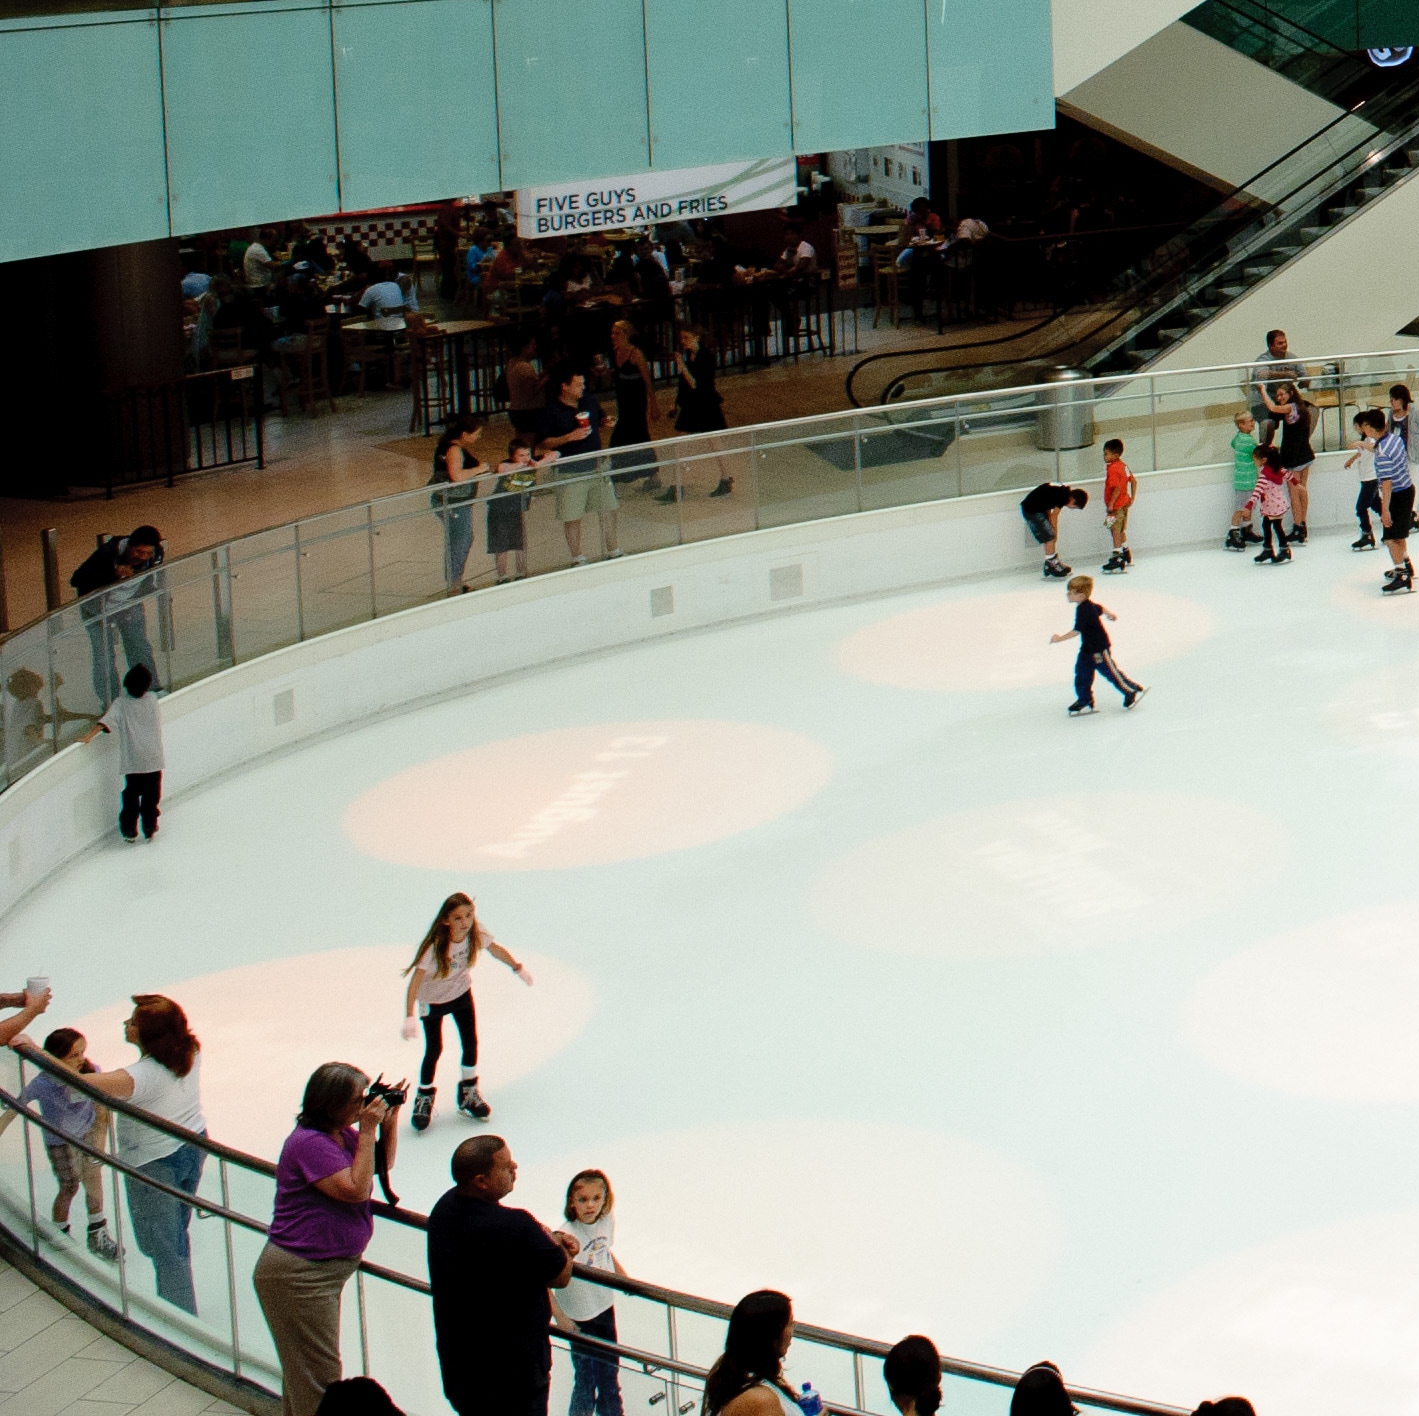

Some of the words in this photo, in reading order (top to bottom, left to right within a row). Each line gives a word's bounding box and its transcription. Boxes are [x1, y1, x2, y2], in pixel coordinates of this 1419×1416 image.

[536, 193, 580, 214] FIVE
[586, 187, 636, 208] GUYS
[537, 207, 627, 233] BURGERS
[632, 202, 672, 222] AND
[678, 195, 729, 216] FRIES
